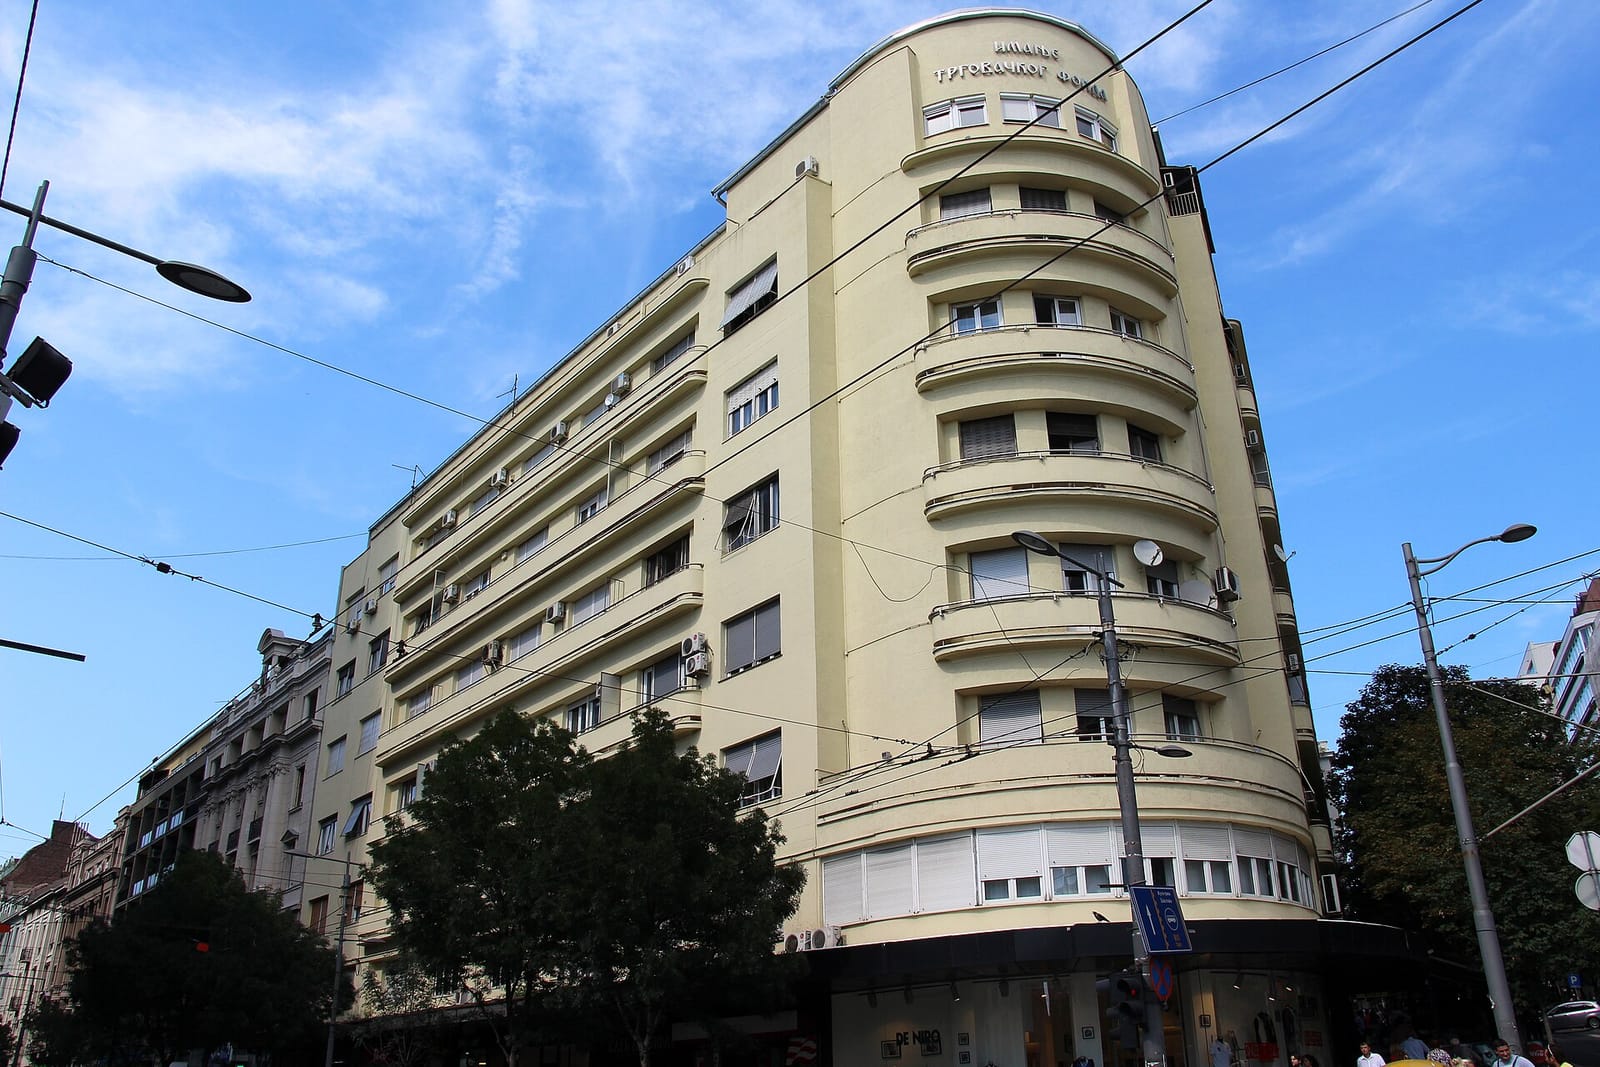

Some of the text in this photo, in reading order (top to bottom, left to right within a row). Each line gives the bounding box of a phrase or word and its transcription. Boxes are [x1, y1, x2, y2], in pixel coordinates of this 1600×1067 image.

[1570, 975, 1578, 985] P
[896, 1029, 941, 1046] DE NIRO
